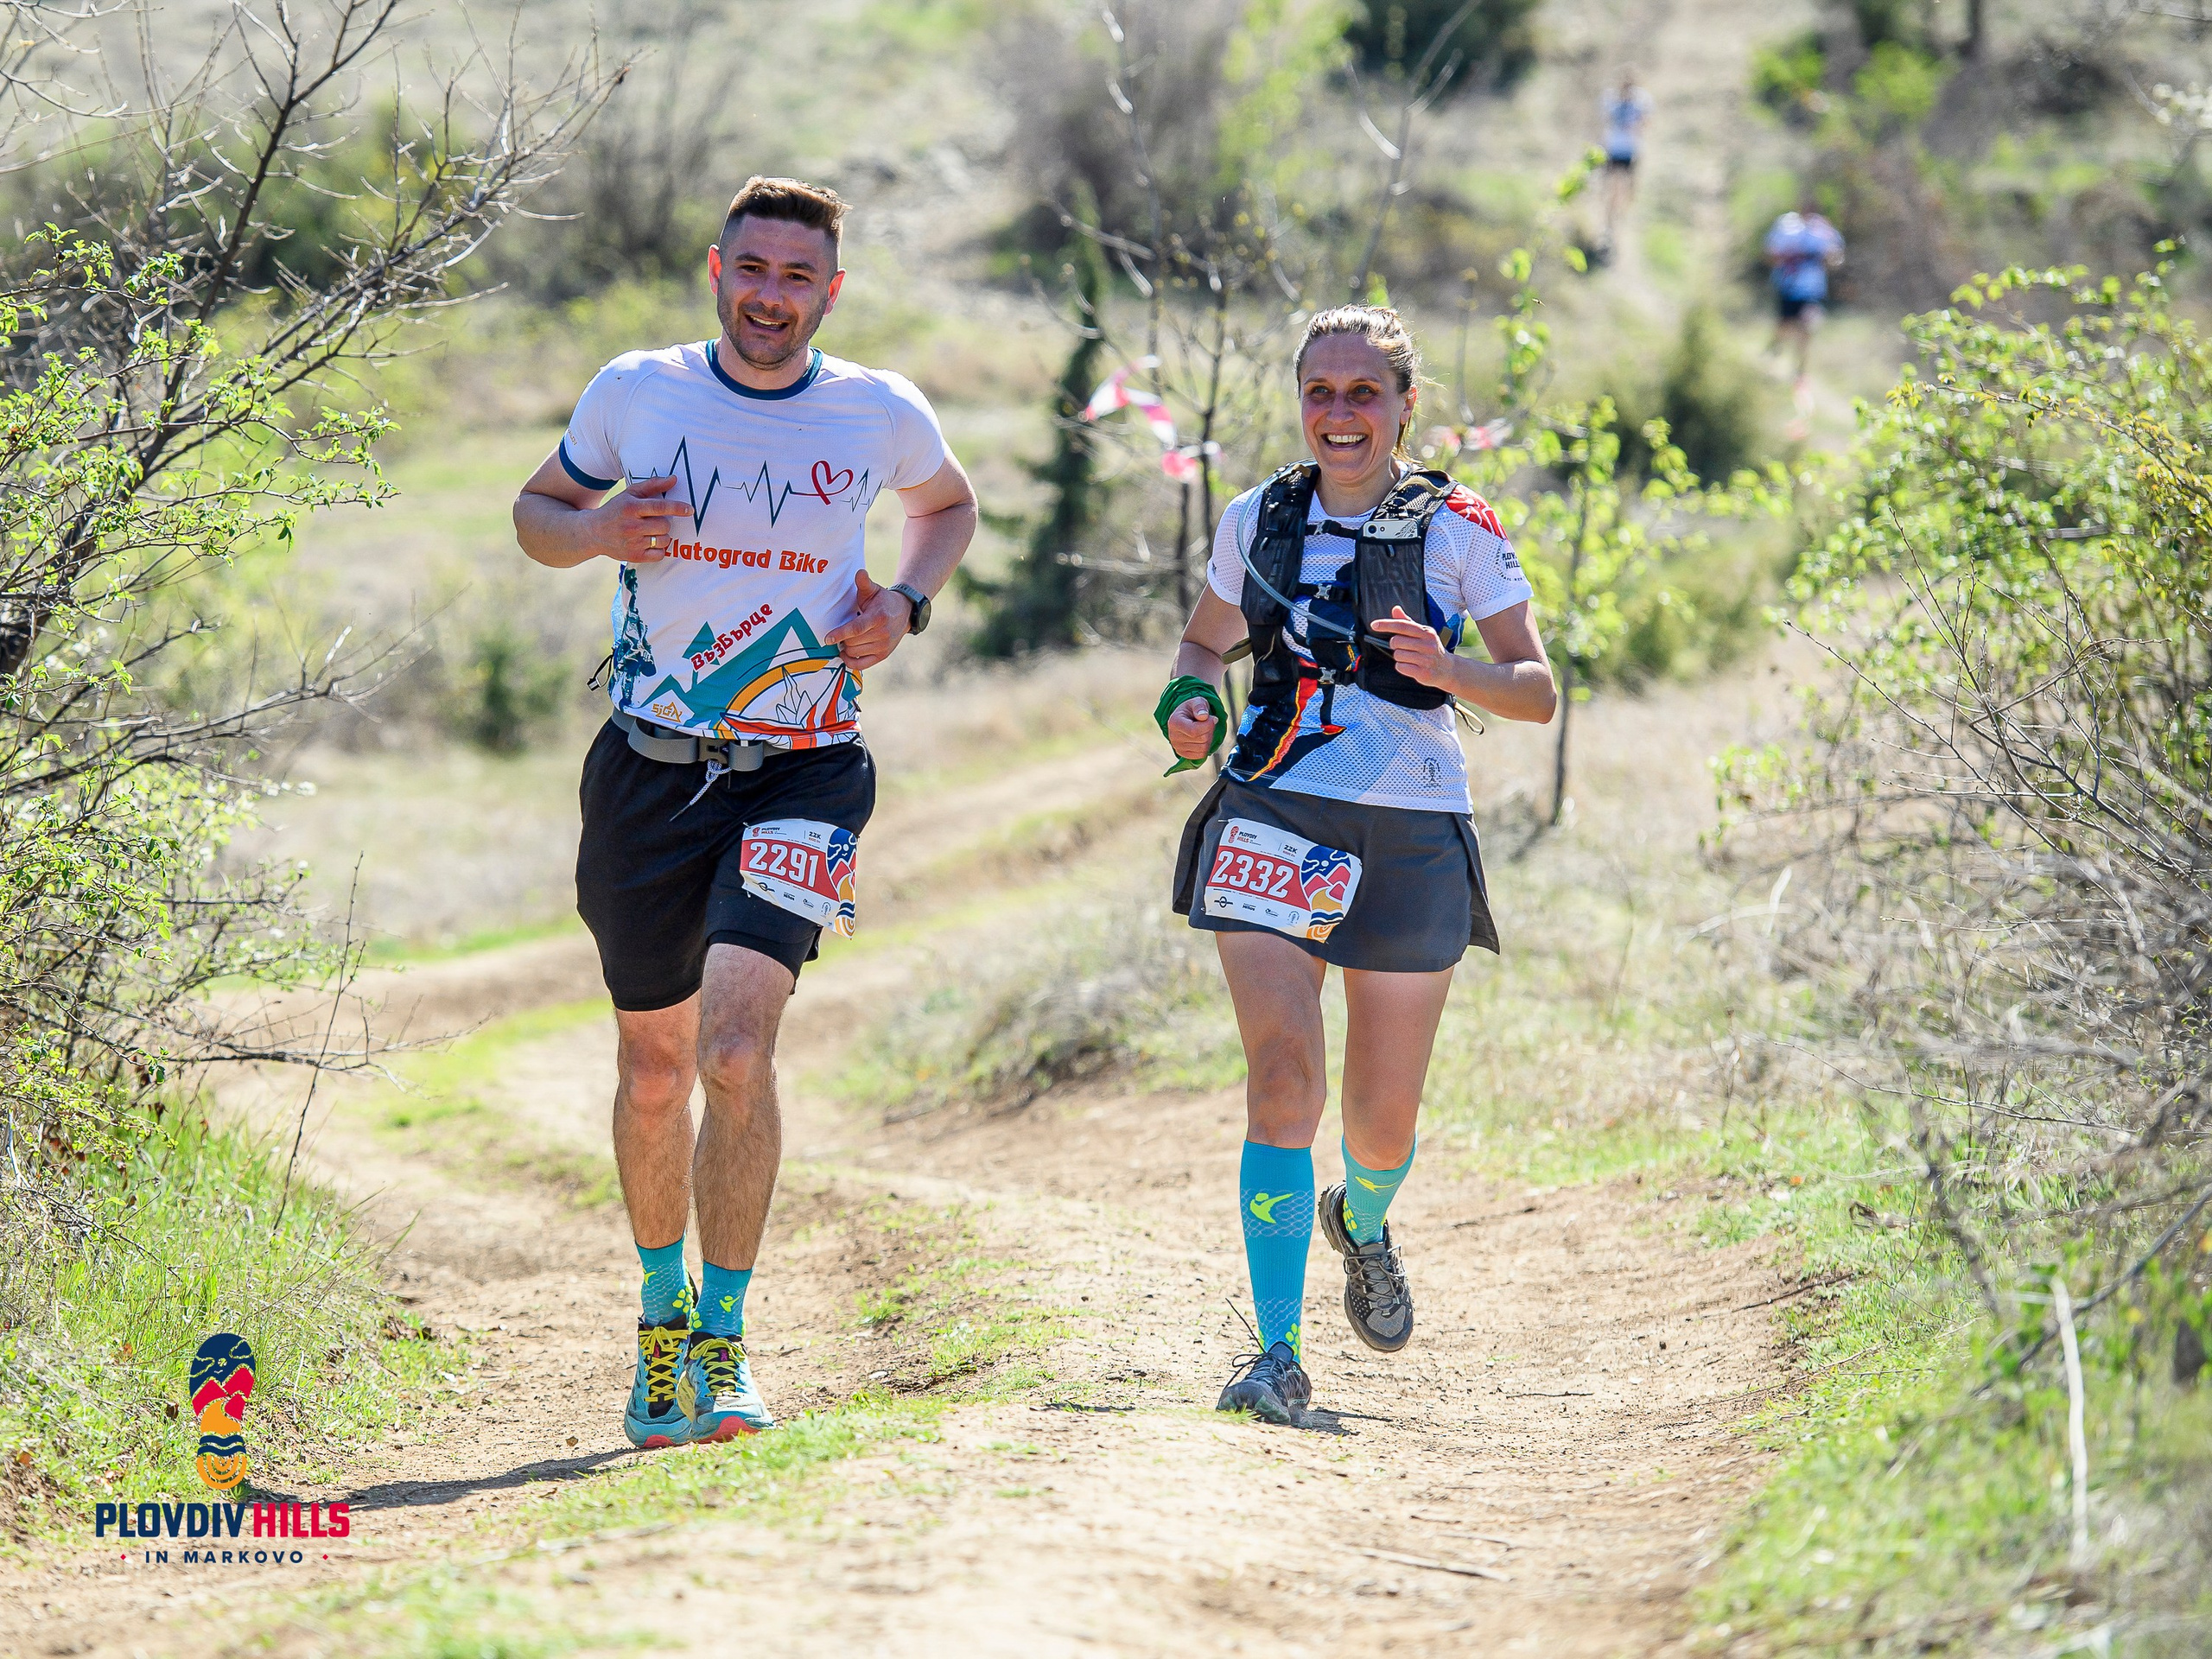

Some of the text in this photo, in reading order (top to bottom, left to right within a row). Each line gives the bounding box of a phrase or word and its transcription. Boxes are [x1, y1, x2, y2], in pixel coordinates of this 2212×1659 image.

[638, 552, 654, 561] PLOV
[779, 550, 829, 573] Bike
[641, 560, 657, 569] HILL
[808, 831, 822, 840] 22K
[1284, 844, 1298, 854] 22K
[748, 842, 819, 888] 2291
[1211, 850, 1294, 899] 2332
